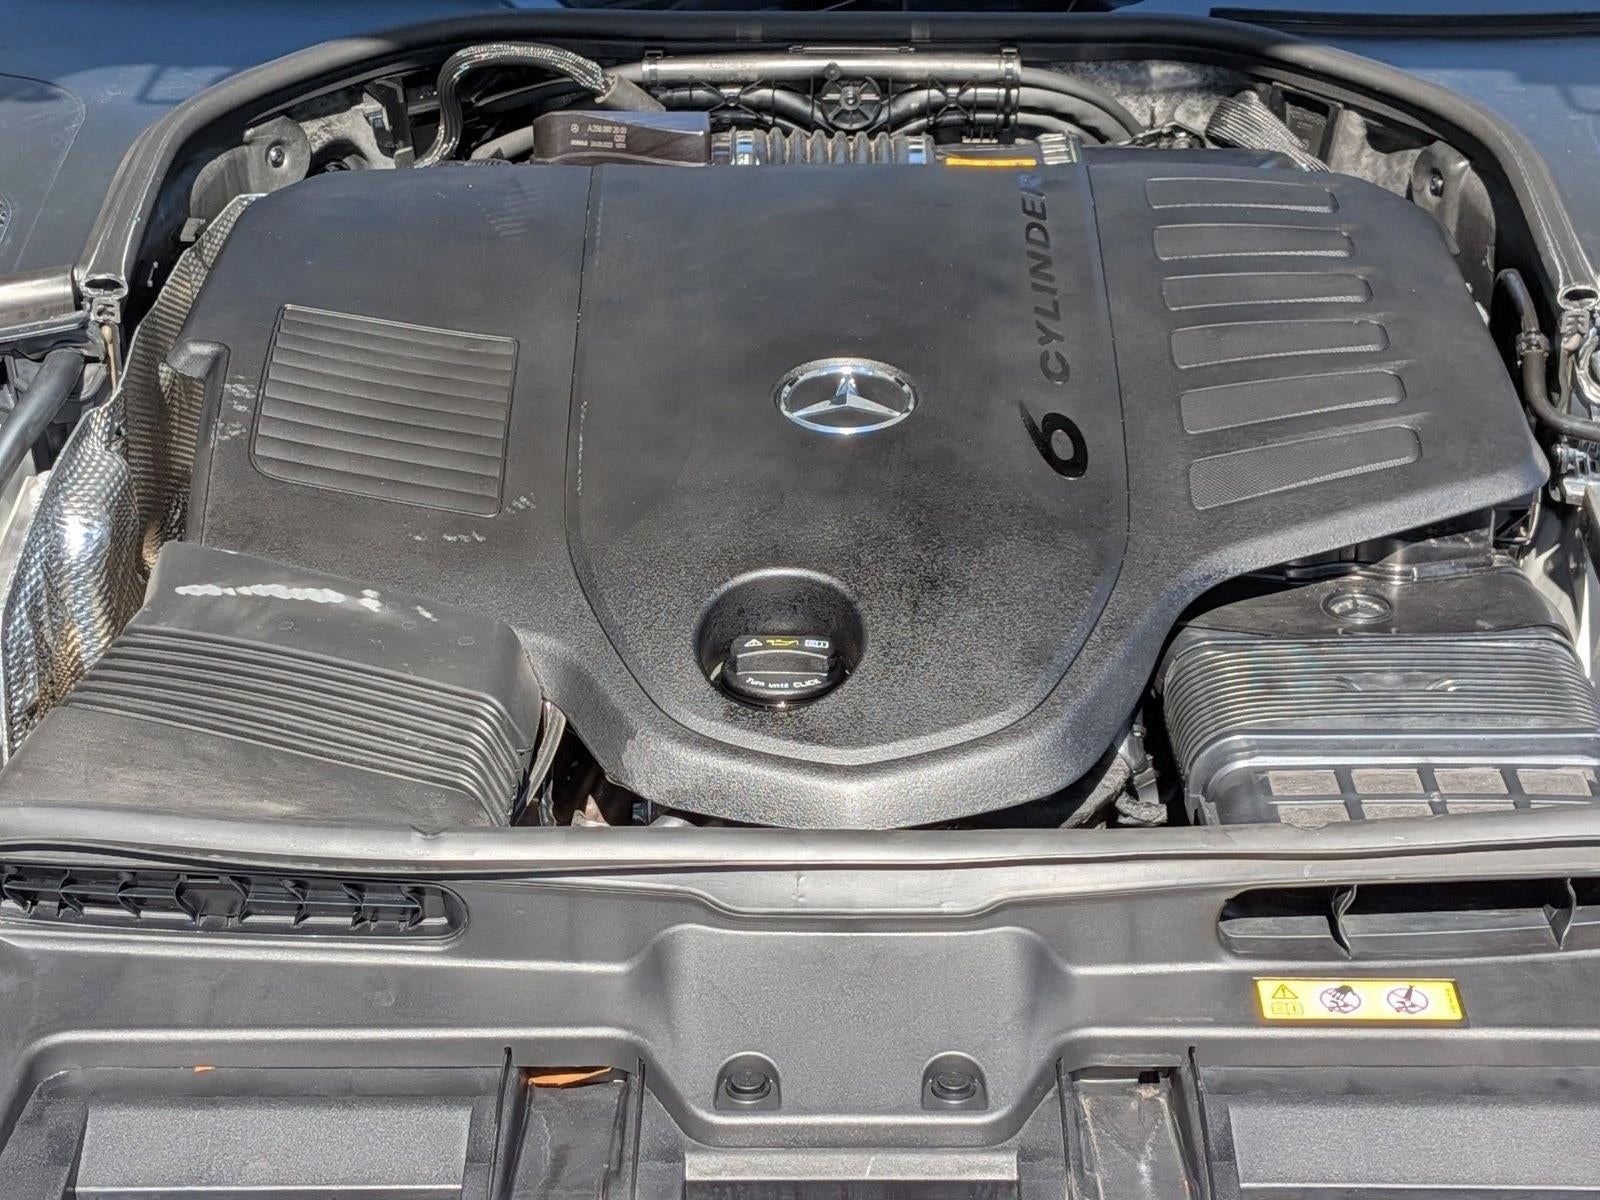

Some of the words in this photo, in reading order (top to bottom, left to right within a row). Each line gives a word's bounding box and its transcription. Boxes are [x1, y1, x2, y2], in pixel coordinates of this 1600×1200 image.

[1019, 400, 1088, 480] 6
[745, 677, 765, 687] Turn
[793, 678, 822, 689] CLICK
